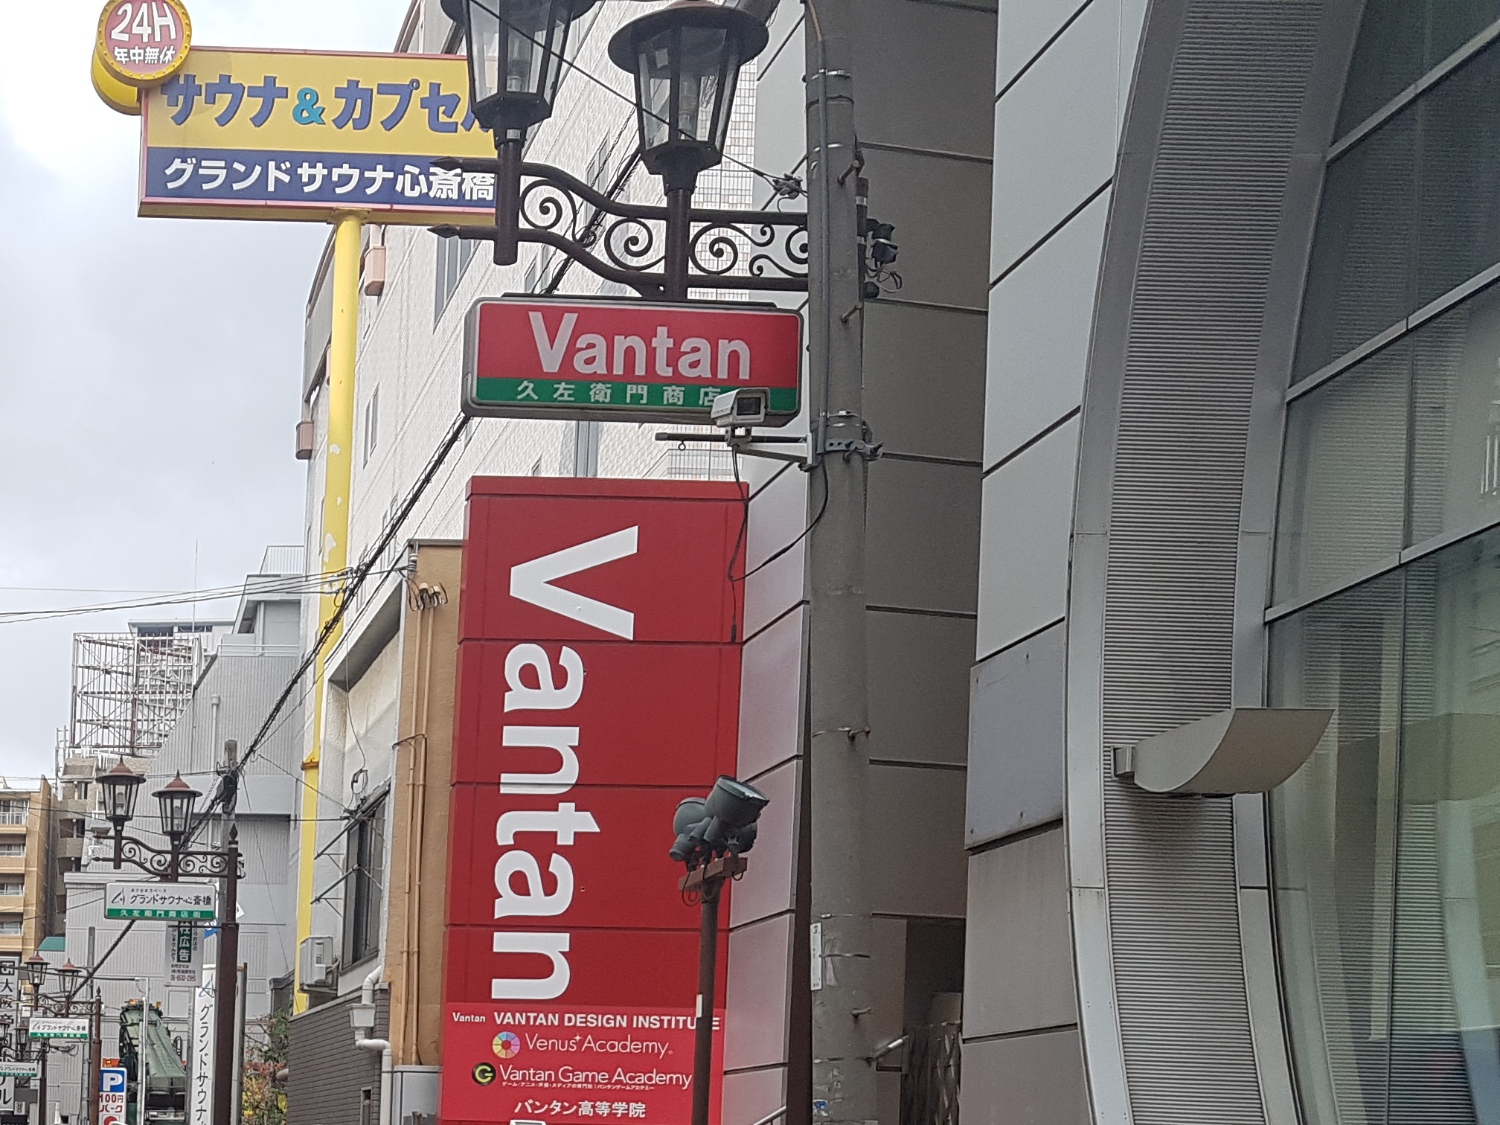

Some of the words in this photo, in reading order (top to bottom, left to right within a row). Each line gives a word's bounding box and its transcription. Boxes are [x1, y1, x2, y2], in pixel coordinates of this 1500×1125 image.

[110, 1, 177, 43] 24H
[113, 46, 176, 64] 年中無休
[528, 311, 751, 380] Vantan
[517, 380, 721, 407] 久左衛門商店
[491, 524, 640, 1000] Vantan
[130, 894, 212, 906] グランドサウナ心斎橋
[452, 1012, 486, 1023] Vantan
[494, 1012, 560, 1027] VANTAN
[563, 1014, 628, 1029] DESIGN
[632, 1015, 721, 1031] INSTITUE
[525, 1033, 577, 1052] Venus
[581, 1034, 669, 1059] Academy
[102, 1072, 123, 1092] P
[499, 1064, 555, 1083] Vantan
[558, 1066, 609, 1084] Game
[611, 1067, 692, 1090] Academy
[514, 1100, 646, 1118] バンタン高等学院
